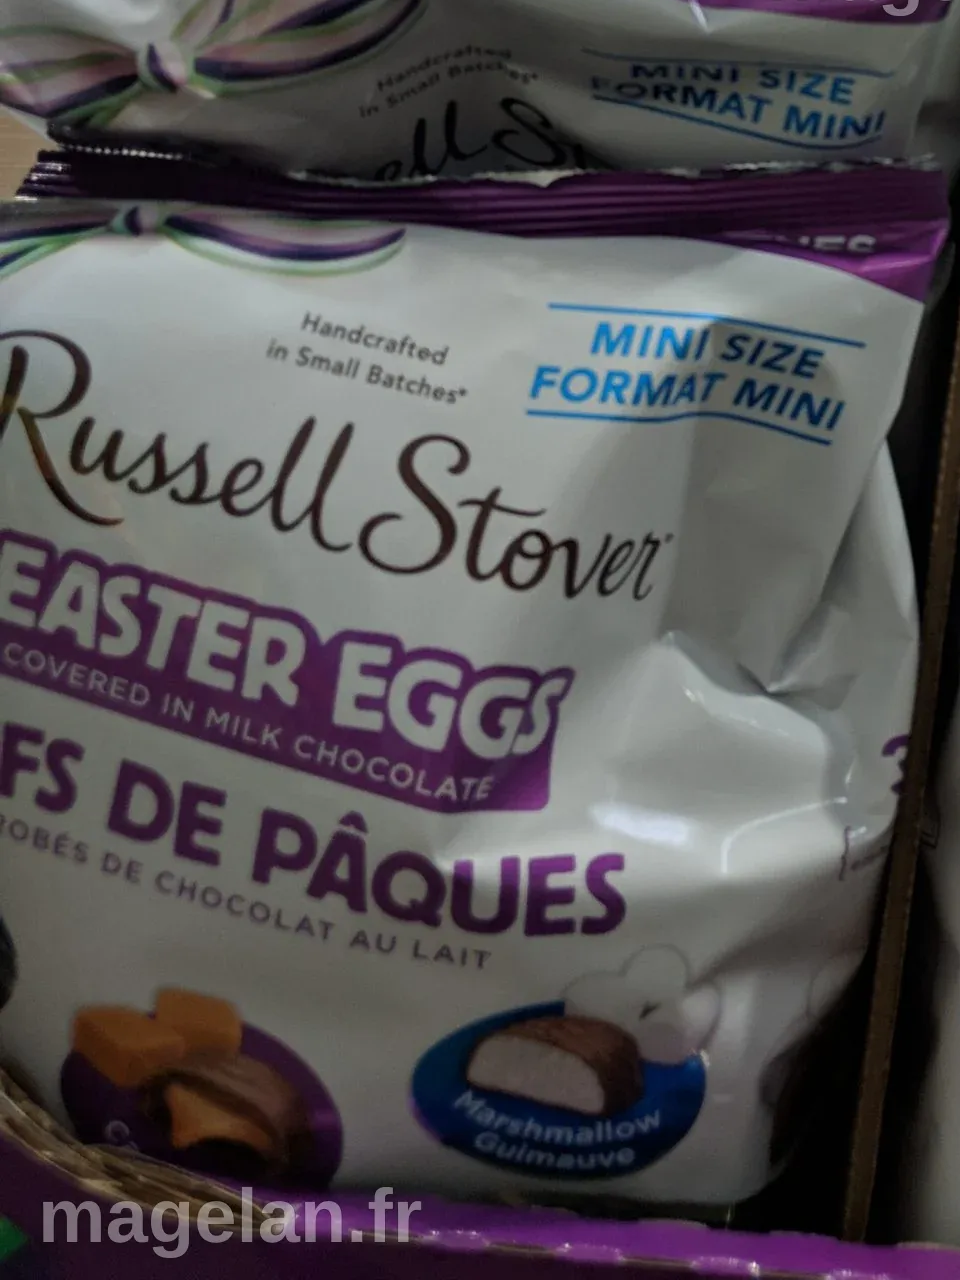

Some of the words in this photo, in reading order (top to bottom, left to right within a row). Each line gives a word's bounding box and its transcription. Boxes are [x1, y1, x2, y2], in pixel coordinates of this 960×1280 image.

[589, 75, 774, 124] FORMAT
[782, 104, 887, 140] MINI
[630, 63, 741, 83] MINI
[758, 68, 856, 106] SIZE
[266, 337, 289, 362] in
[294, 349, 360, 381] Small
[301, 311, 451, 367] Handcrafted
[590, 321, 712, 362] MINI
[719, 331, 826, 380] SIZE
[528, 365, 728, 408] FORMAT
[732, 377, 847, 432] MINI
[0, 329, 355, 553] Russell
[357, 432, 668, 602] Stover
[0, 538, 307, 708] EASTER
[330, 639, 570, 761] EGGS
[2, 641, 151, 709] COVERED
[160, 693, 196, 724] IN
[206, 705, 282, 752] MILK
[293, 734, 497, 803] CHOCOLATE
[107, 757, 228, 867] DE
[250, 810, 628, 938] PÂQUES
[101, 851, 144, 886] DE
[154, 868, 336, 942] CHOCOLAT
[348, 928, 399, 957] AU
[410, 941, 494, 971] LAIT
[453, 1088, 662, 1147] Marshmallow
[474, 1130, 637, 1170] Guimauve
